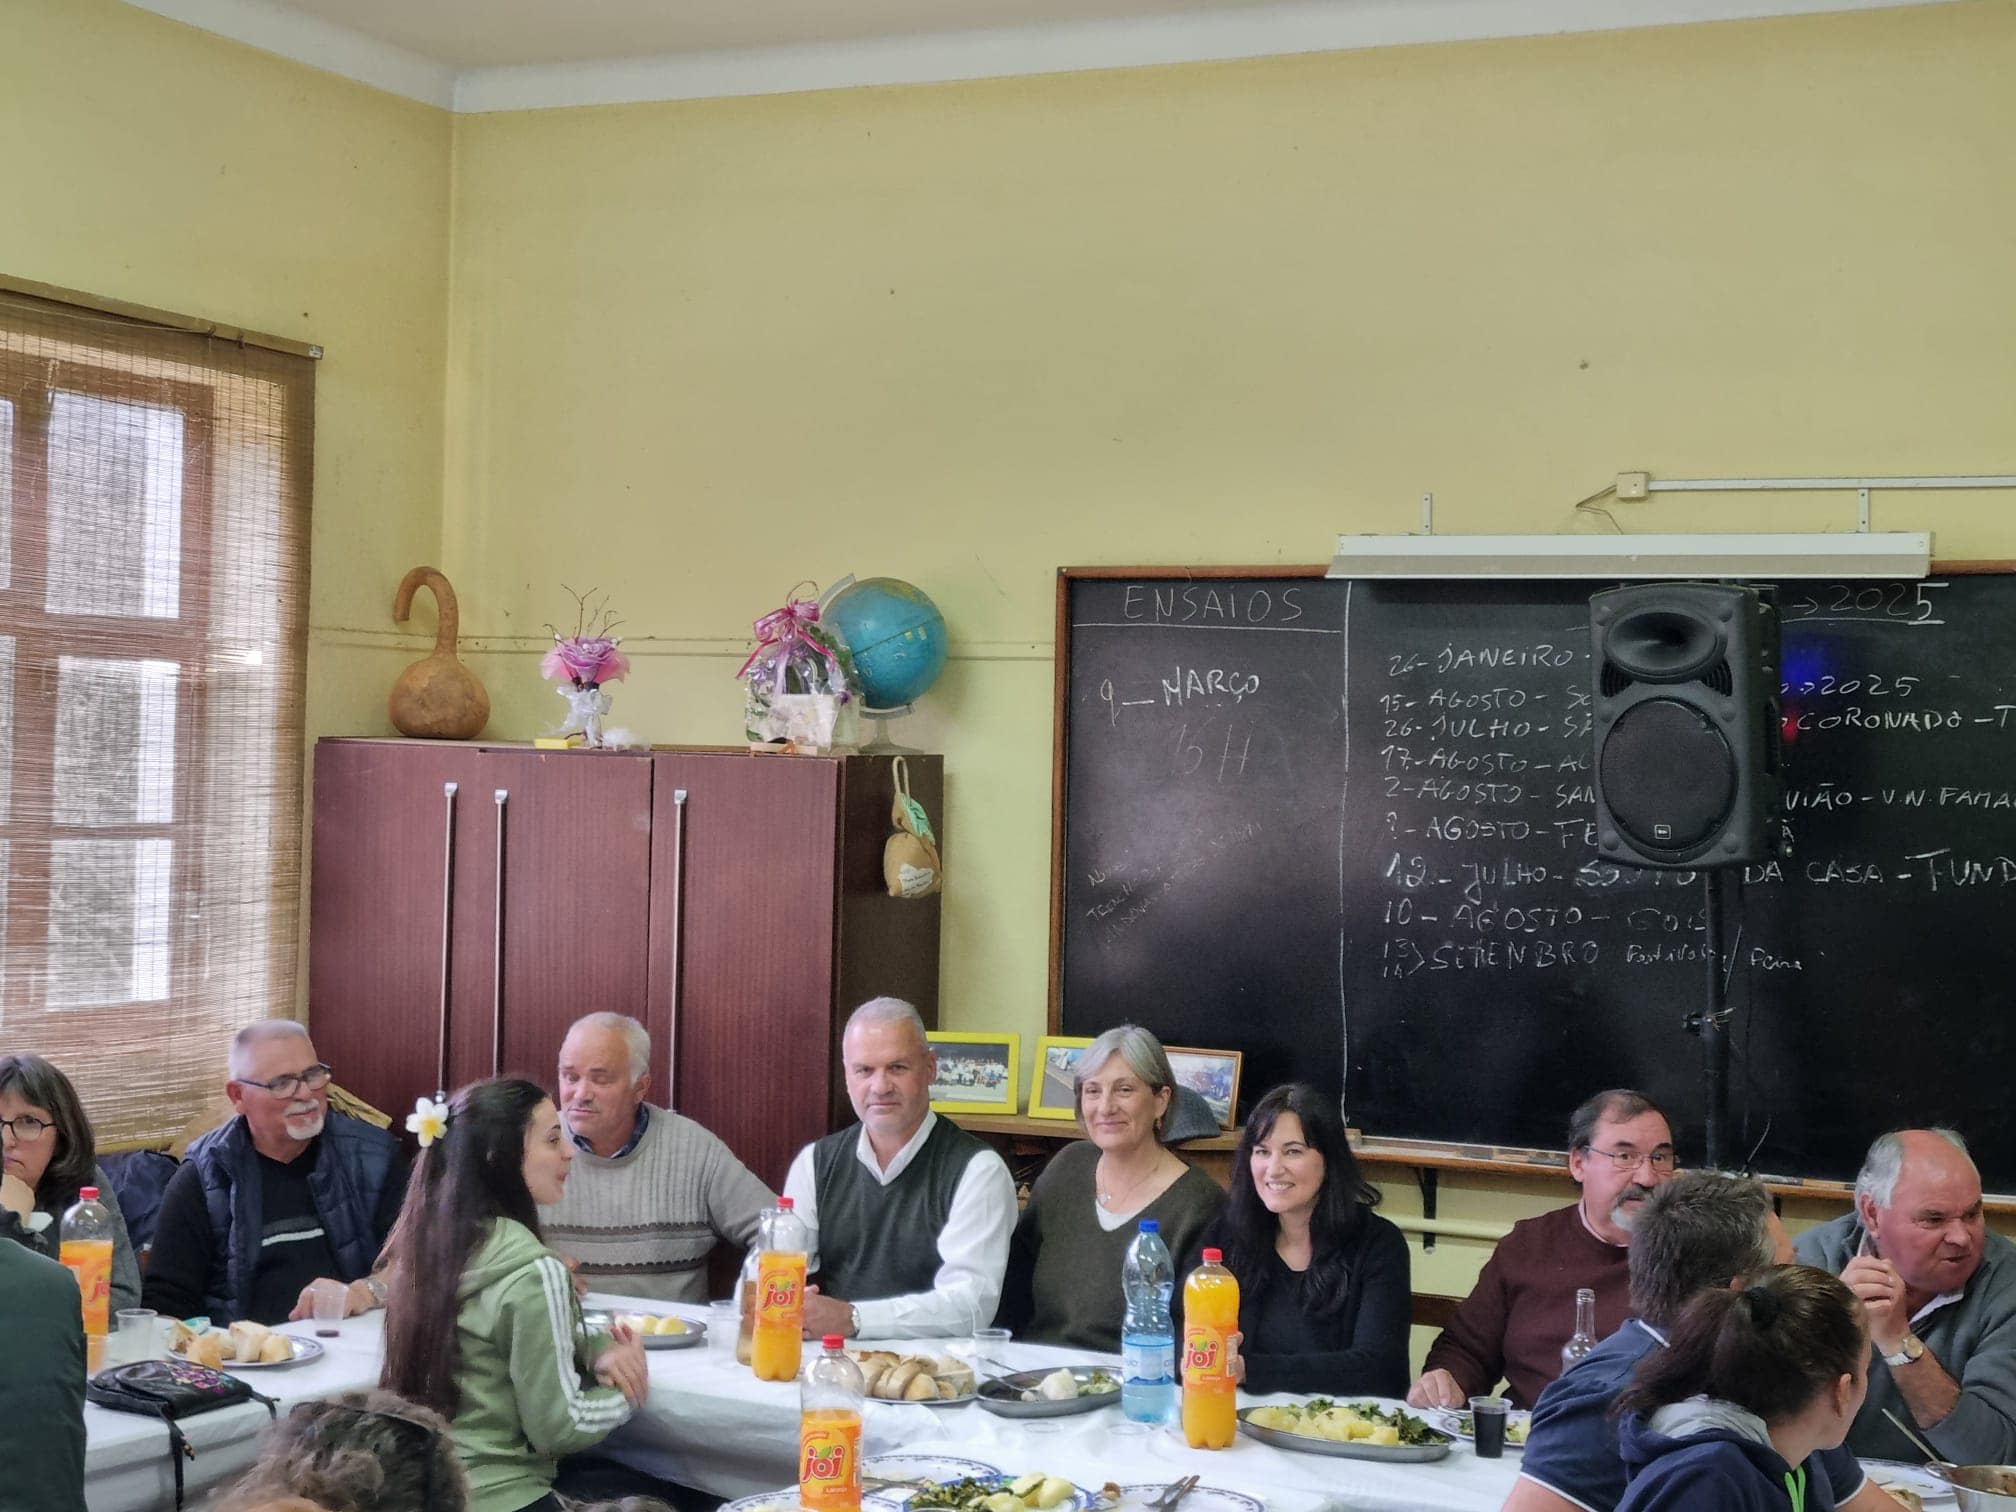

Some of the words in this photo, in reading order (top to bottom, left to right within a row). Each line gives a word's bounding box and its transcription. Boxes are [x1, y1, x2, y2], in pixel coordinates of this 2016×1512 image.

[1124, 585, 1302, 622] ENSAIOS
[1829, 582, 1949, 621] 2025
[1429, 687, 1527, 712] AGOSTO
[1796, 706, 1963, 732] CORONADO
[1429, 747, 1528, 776] AGOSTO
[1744, 860, 1784, 885] DA
[1806, 860, 1884, 885] CASA
[1453, 901, 1582, 932] AGOSTO
